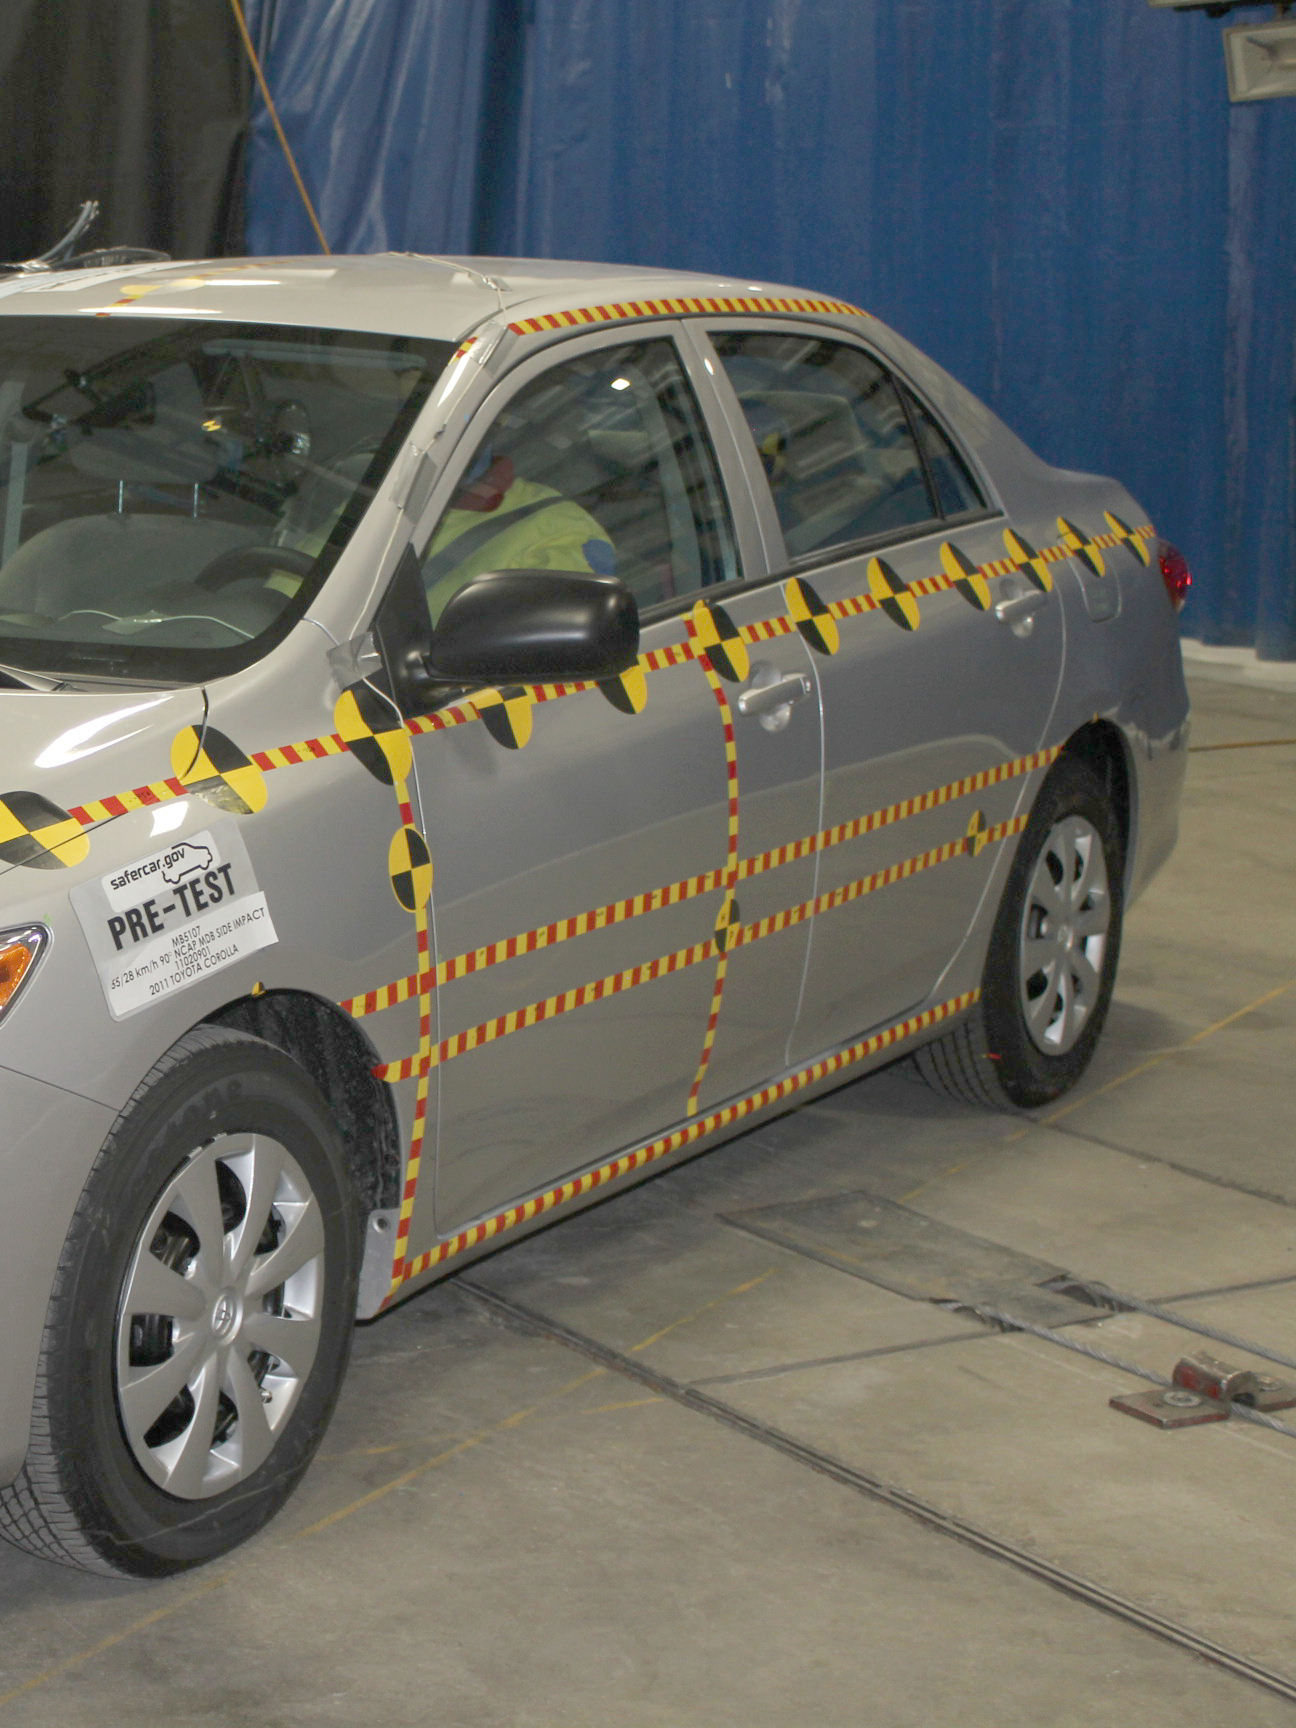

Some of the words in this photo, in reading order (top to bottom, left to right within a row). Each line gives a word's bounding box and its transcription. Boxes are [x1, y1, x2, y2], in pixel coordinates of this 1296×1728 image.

[110, 847, 186, 890] safercar.gov
[107, 863, 236, 951] PRE-TEST
[111, 970, 135, 990] 55/28
[135, 959, 159, 978] km/h
[174, 940, 197, 959] NCAP
[198, 931, 216, 947] MDB
[216, 922, 233, 938] SIDE
[233, 907, 265, 929] IMPACT
[171, 925, 202, 948] MB5107
[175, 945, 211, 971] 11020901
[149, 978, 170, 996] 2011
[170, 963, 203, 986] TOYOTA
[204, 943, 240, 969] COROLLA
